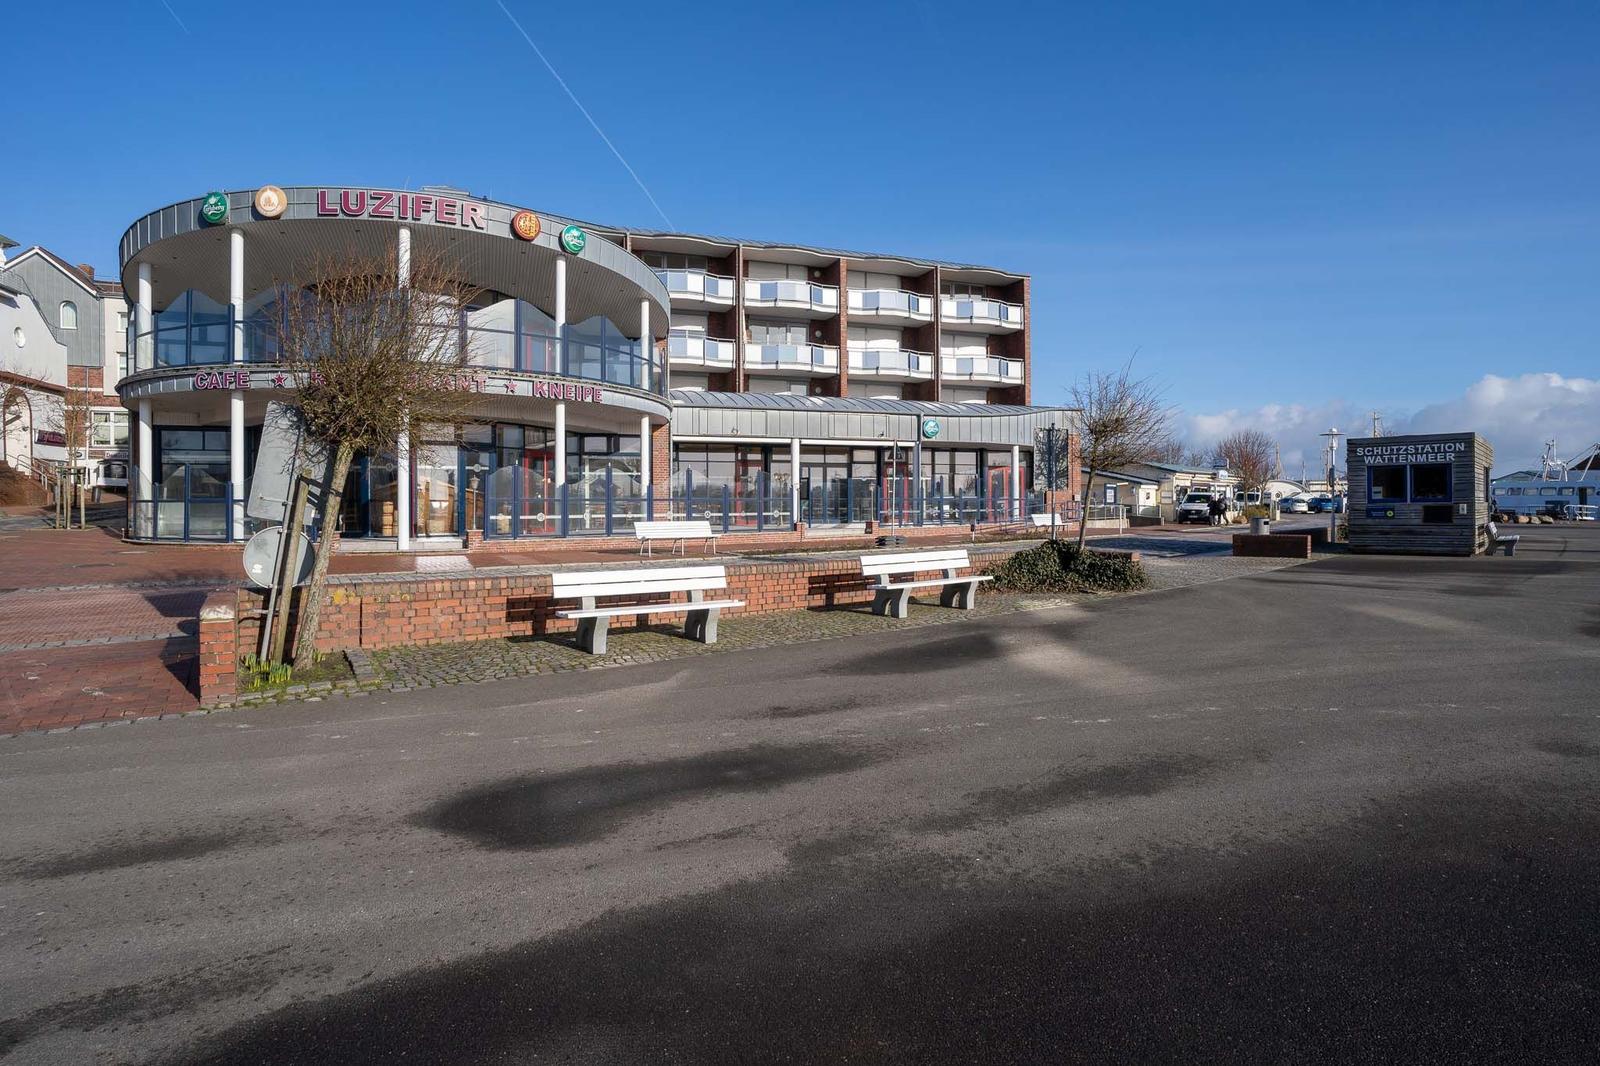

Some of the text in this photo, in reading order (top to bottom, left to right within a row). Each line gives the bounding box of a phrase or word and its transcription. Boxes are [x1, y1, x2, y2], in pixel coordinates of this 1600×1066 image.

[318, 189, 487, 230] LUZIFER
[194, 370, 250, 390] CAFE
[533, 380, 603, 403] KNEIPE
[1356, 442, 1465, 456] SCHUTZSTATION
[1364, 452, 1456, 464] WATTENMEER
